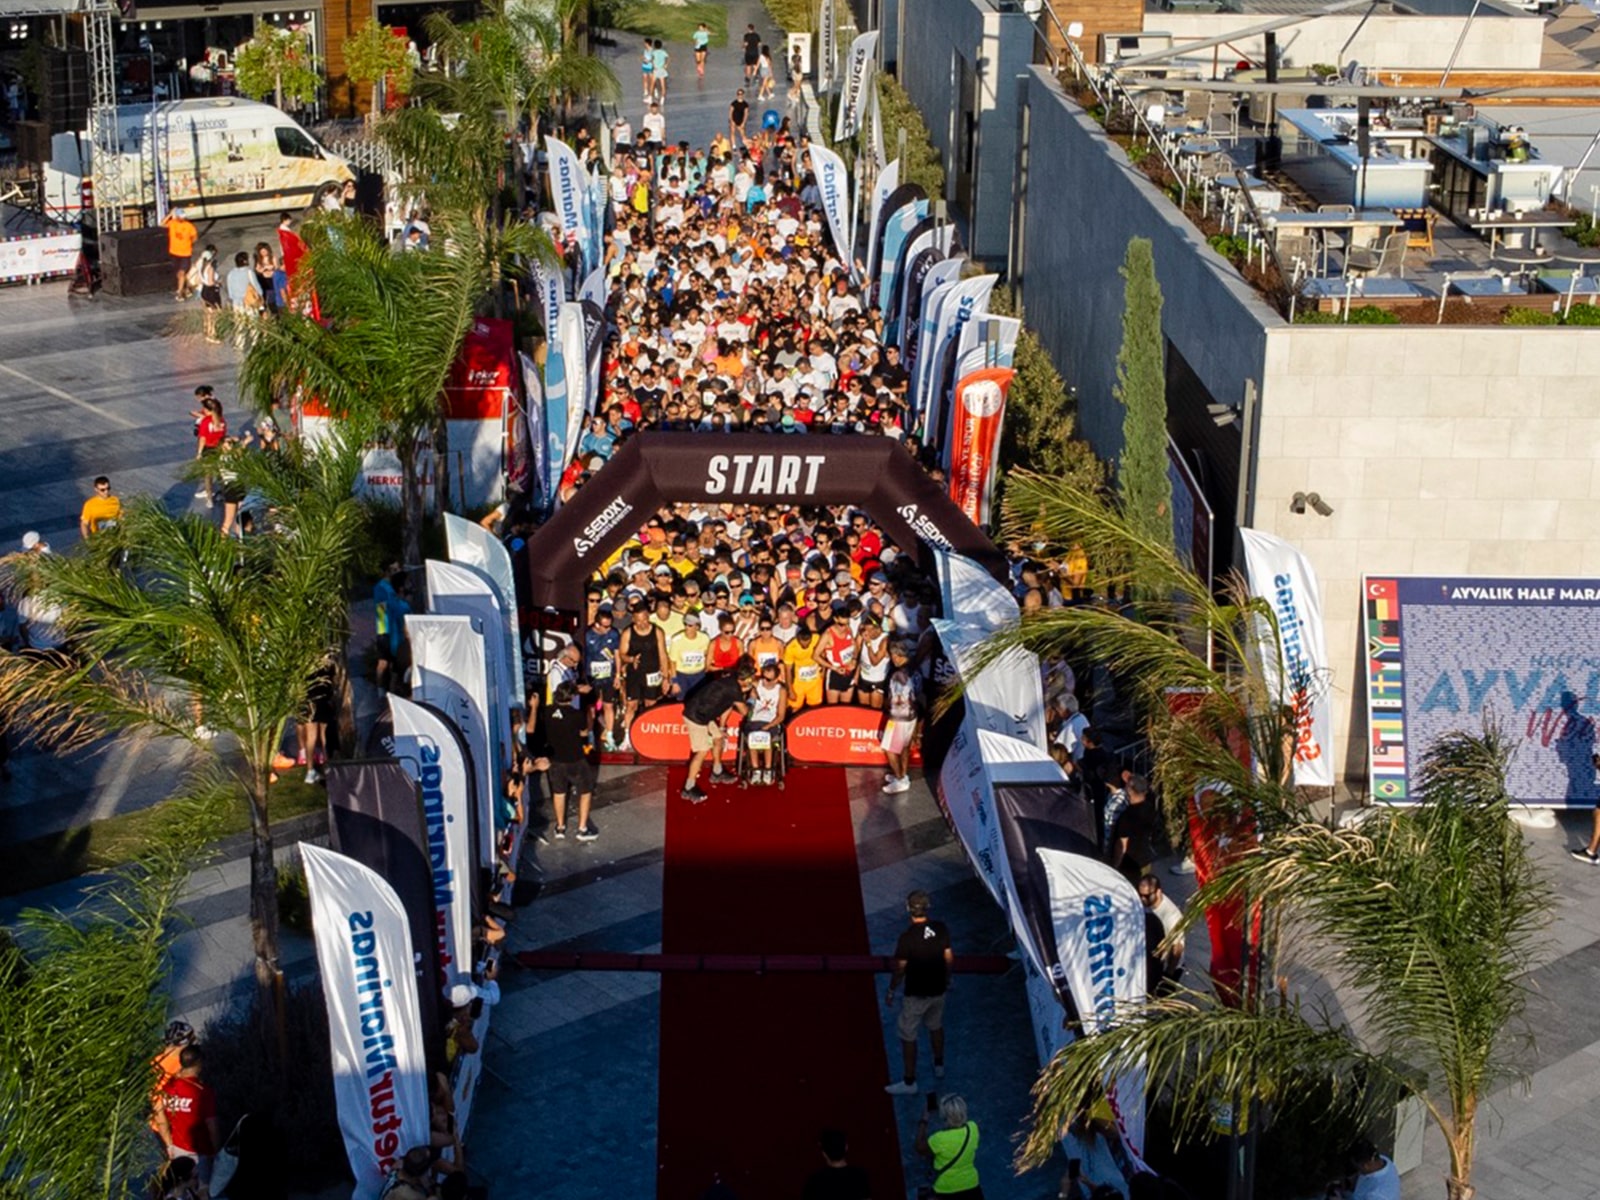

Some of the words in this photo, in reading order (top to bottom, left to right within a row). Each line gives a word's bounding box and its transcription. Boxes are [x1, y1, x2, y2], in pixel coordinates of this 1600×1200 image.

[843, 47, 865, 130] STARBUCKS
[705, 454, 826, 495] START
[583, 495, 627, 539] SEDOXY
[1452, 587, 1513, 600] AYVALIK
[1518, 588, 1555, 600] HALF
[641, 722, 689, 735] UNITED
[795, 726, 846, 739] UNITED
